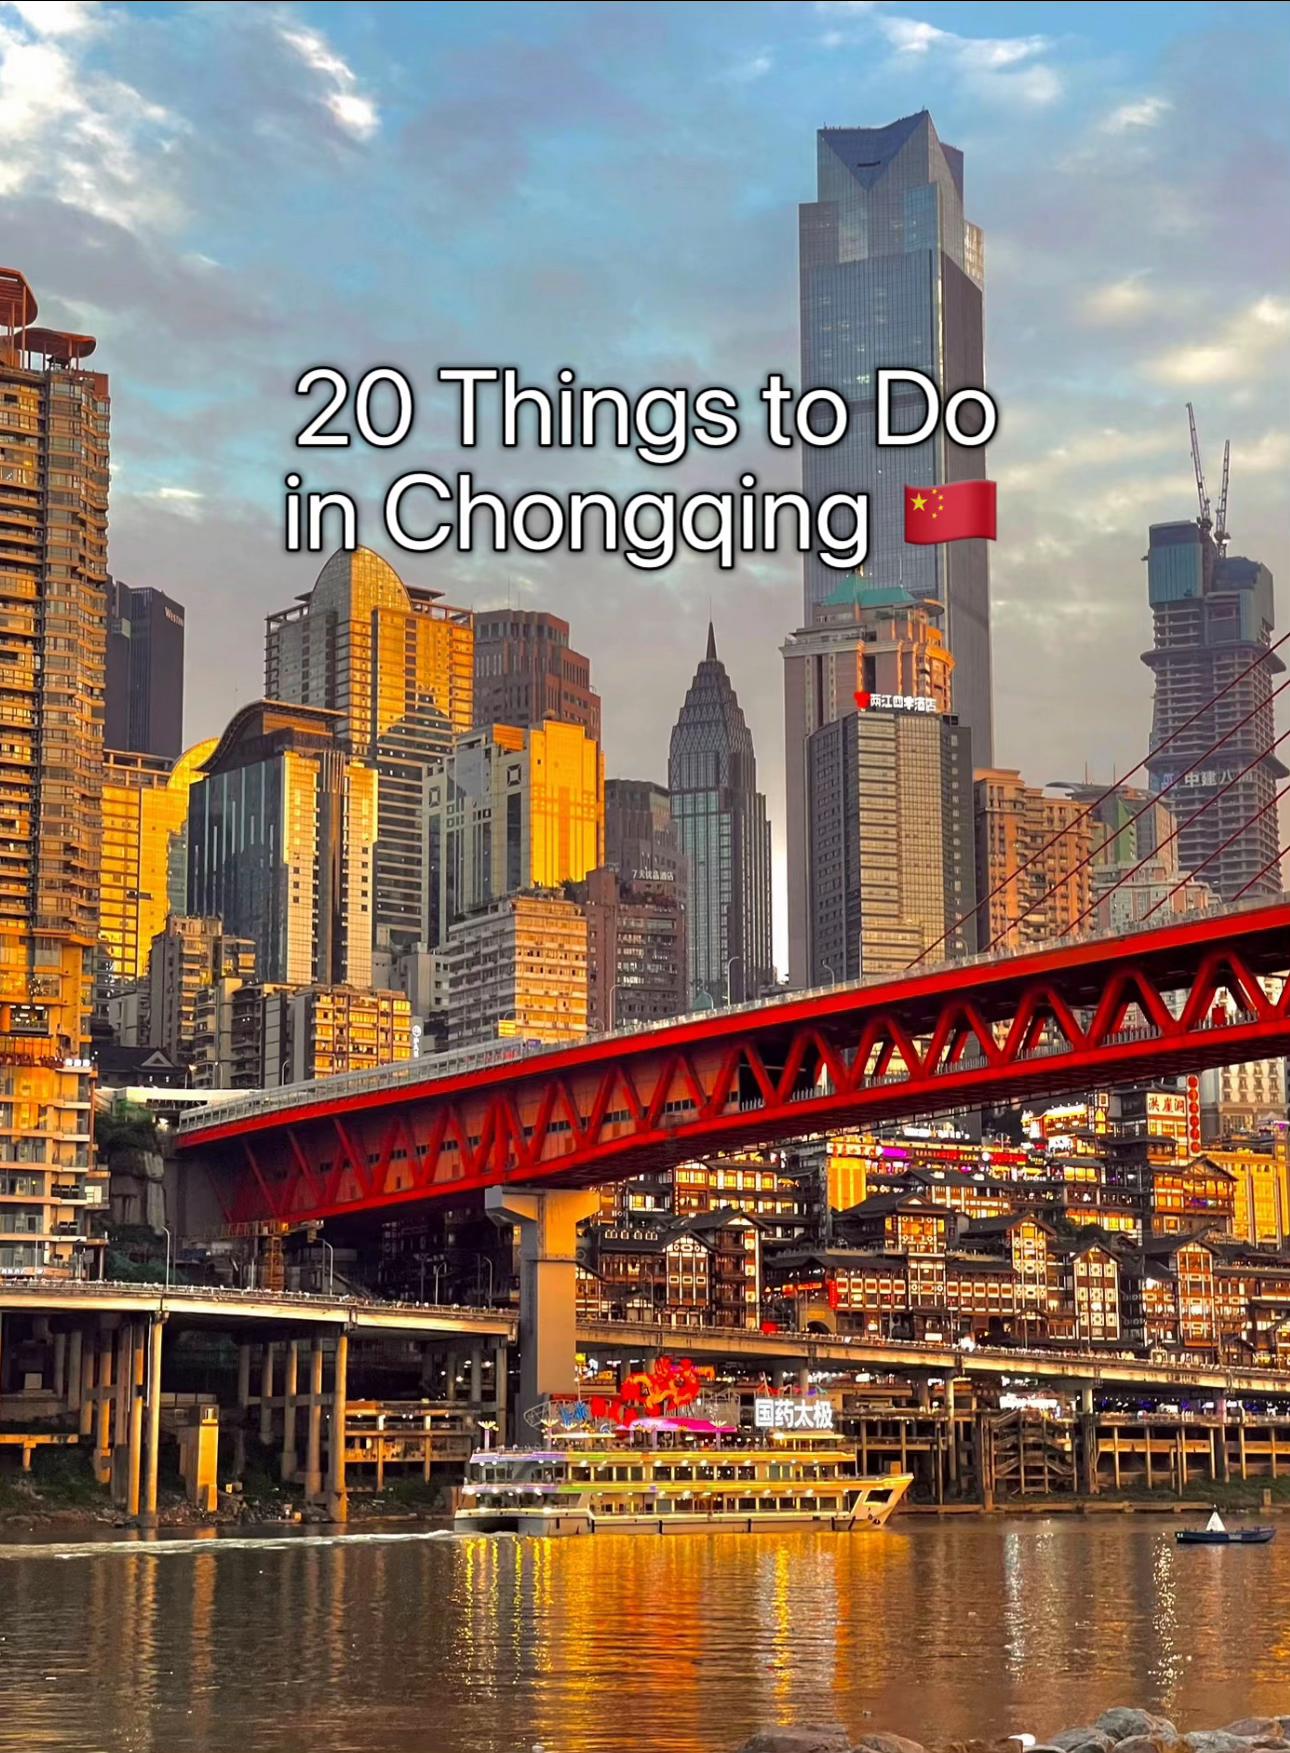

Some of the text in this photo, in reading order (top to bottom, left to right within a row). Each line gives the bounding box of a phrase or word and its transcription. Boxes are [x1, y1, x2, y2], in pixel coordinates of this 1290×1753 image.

[1148, 1095, 1185, 1113] 洪崖洞
[755, 1399, 834, 1429] 国药太极
